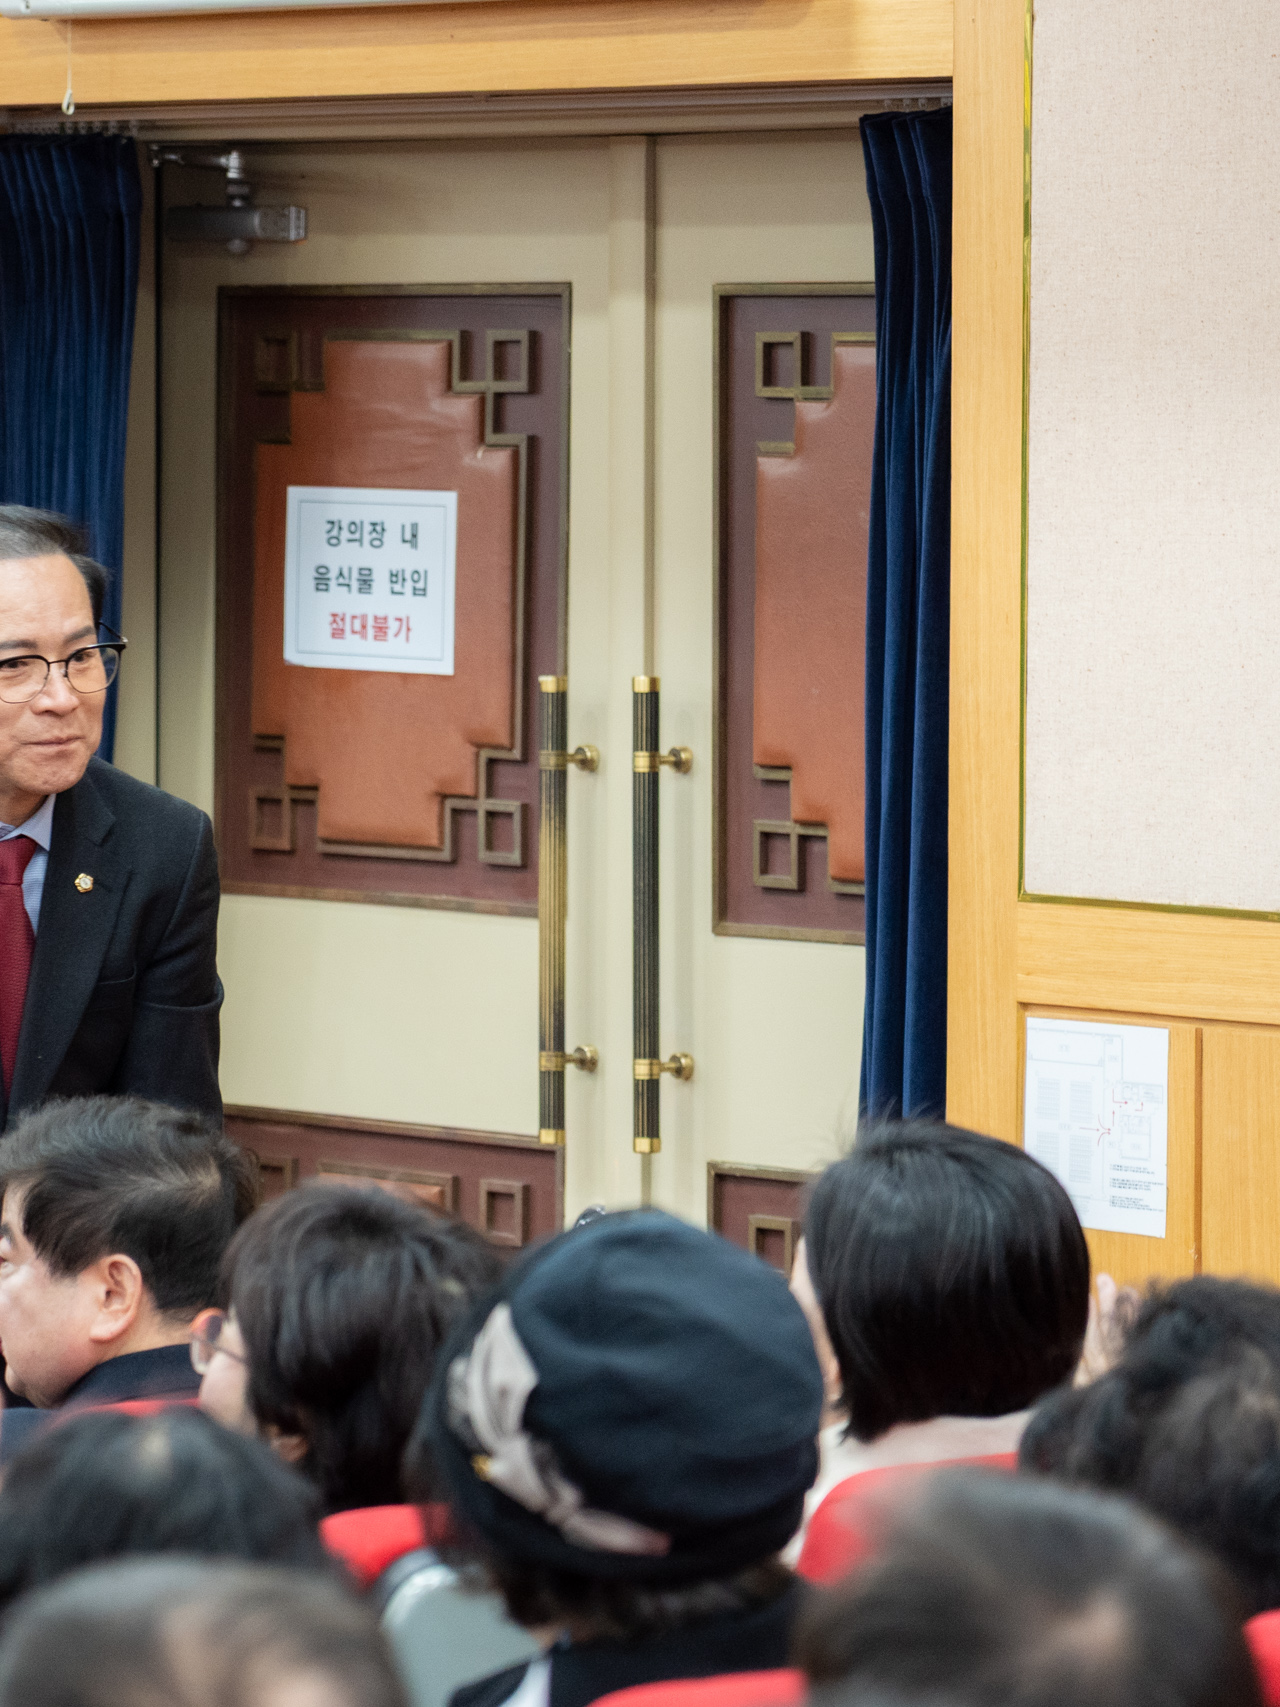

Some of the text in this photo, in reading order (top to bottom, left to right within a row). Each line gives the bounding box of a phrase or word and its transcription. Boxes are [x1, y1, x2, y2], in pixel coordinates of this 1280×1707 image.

[325, 519, 418, 550] 강의장 내
[313, 564, 428, 597] 음식물 반입
[329, 612, 412, 643] 절대불가
